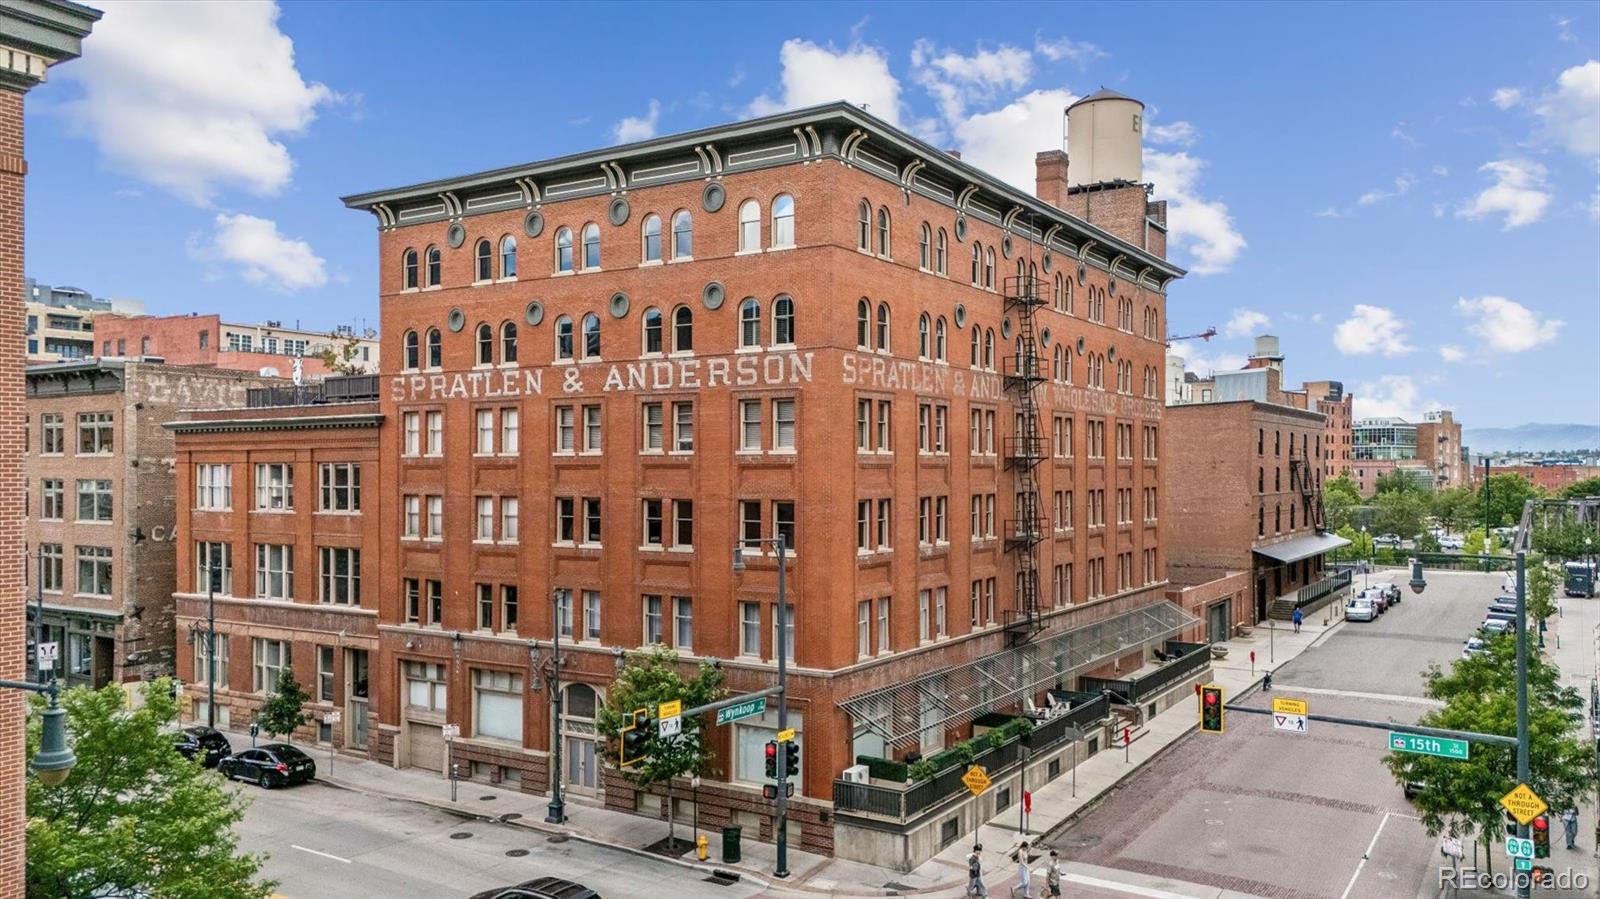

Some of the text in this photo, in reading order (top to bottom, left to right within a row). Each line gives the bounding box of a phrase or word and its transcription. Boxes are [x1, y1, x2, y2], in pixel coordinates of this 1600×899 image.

[1132, 113, 1142, 133] E
[391, 352, 814, 401] SPRATLEN & ANDERSON
[842, 353, 949, 395] SPRATLEN
[953, 371, 966, 396] &
[1053, 386, 1117, 415] WHOLESALE
[725, 704, 755, 720] Wynkoop
[1410, 738, 1440, 752] 15th
[1508, 800, 1540, 809] THROUGH
[1513, 807, 1534, 816] STREET
